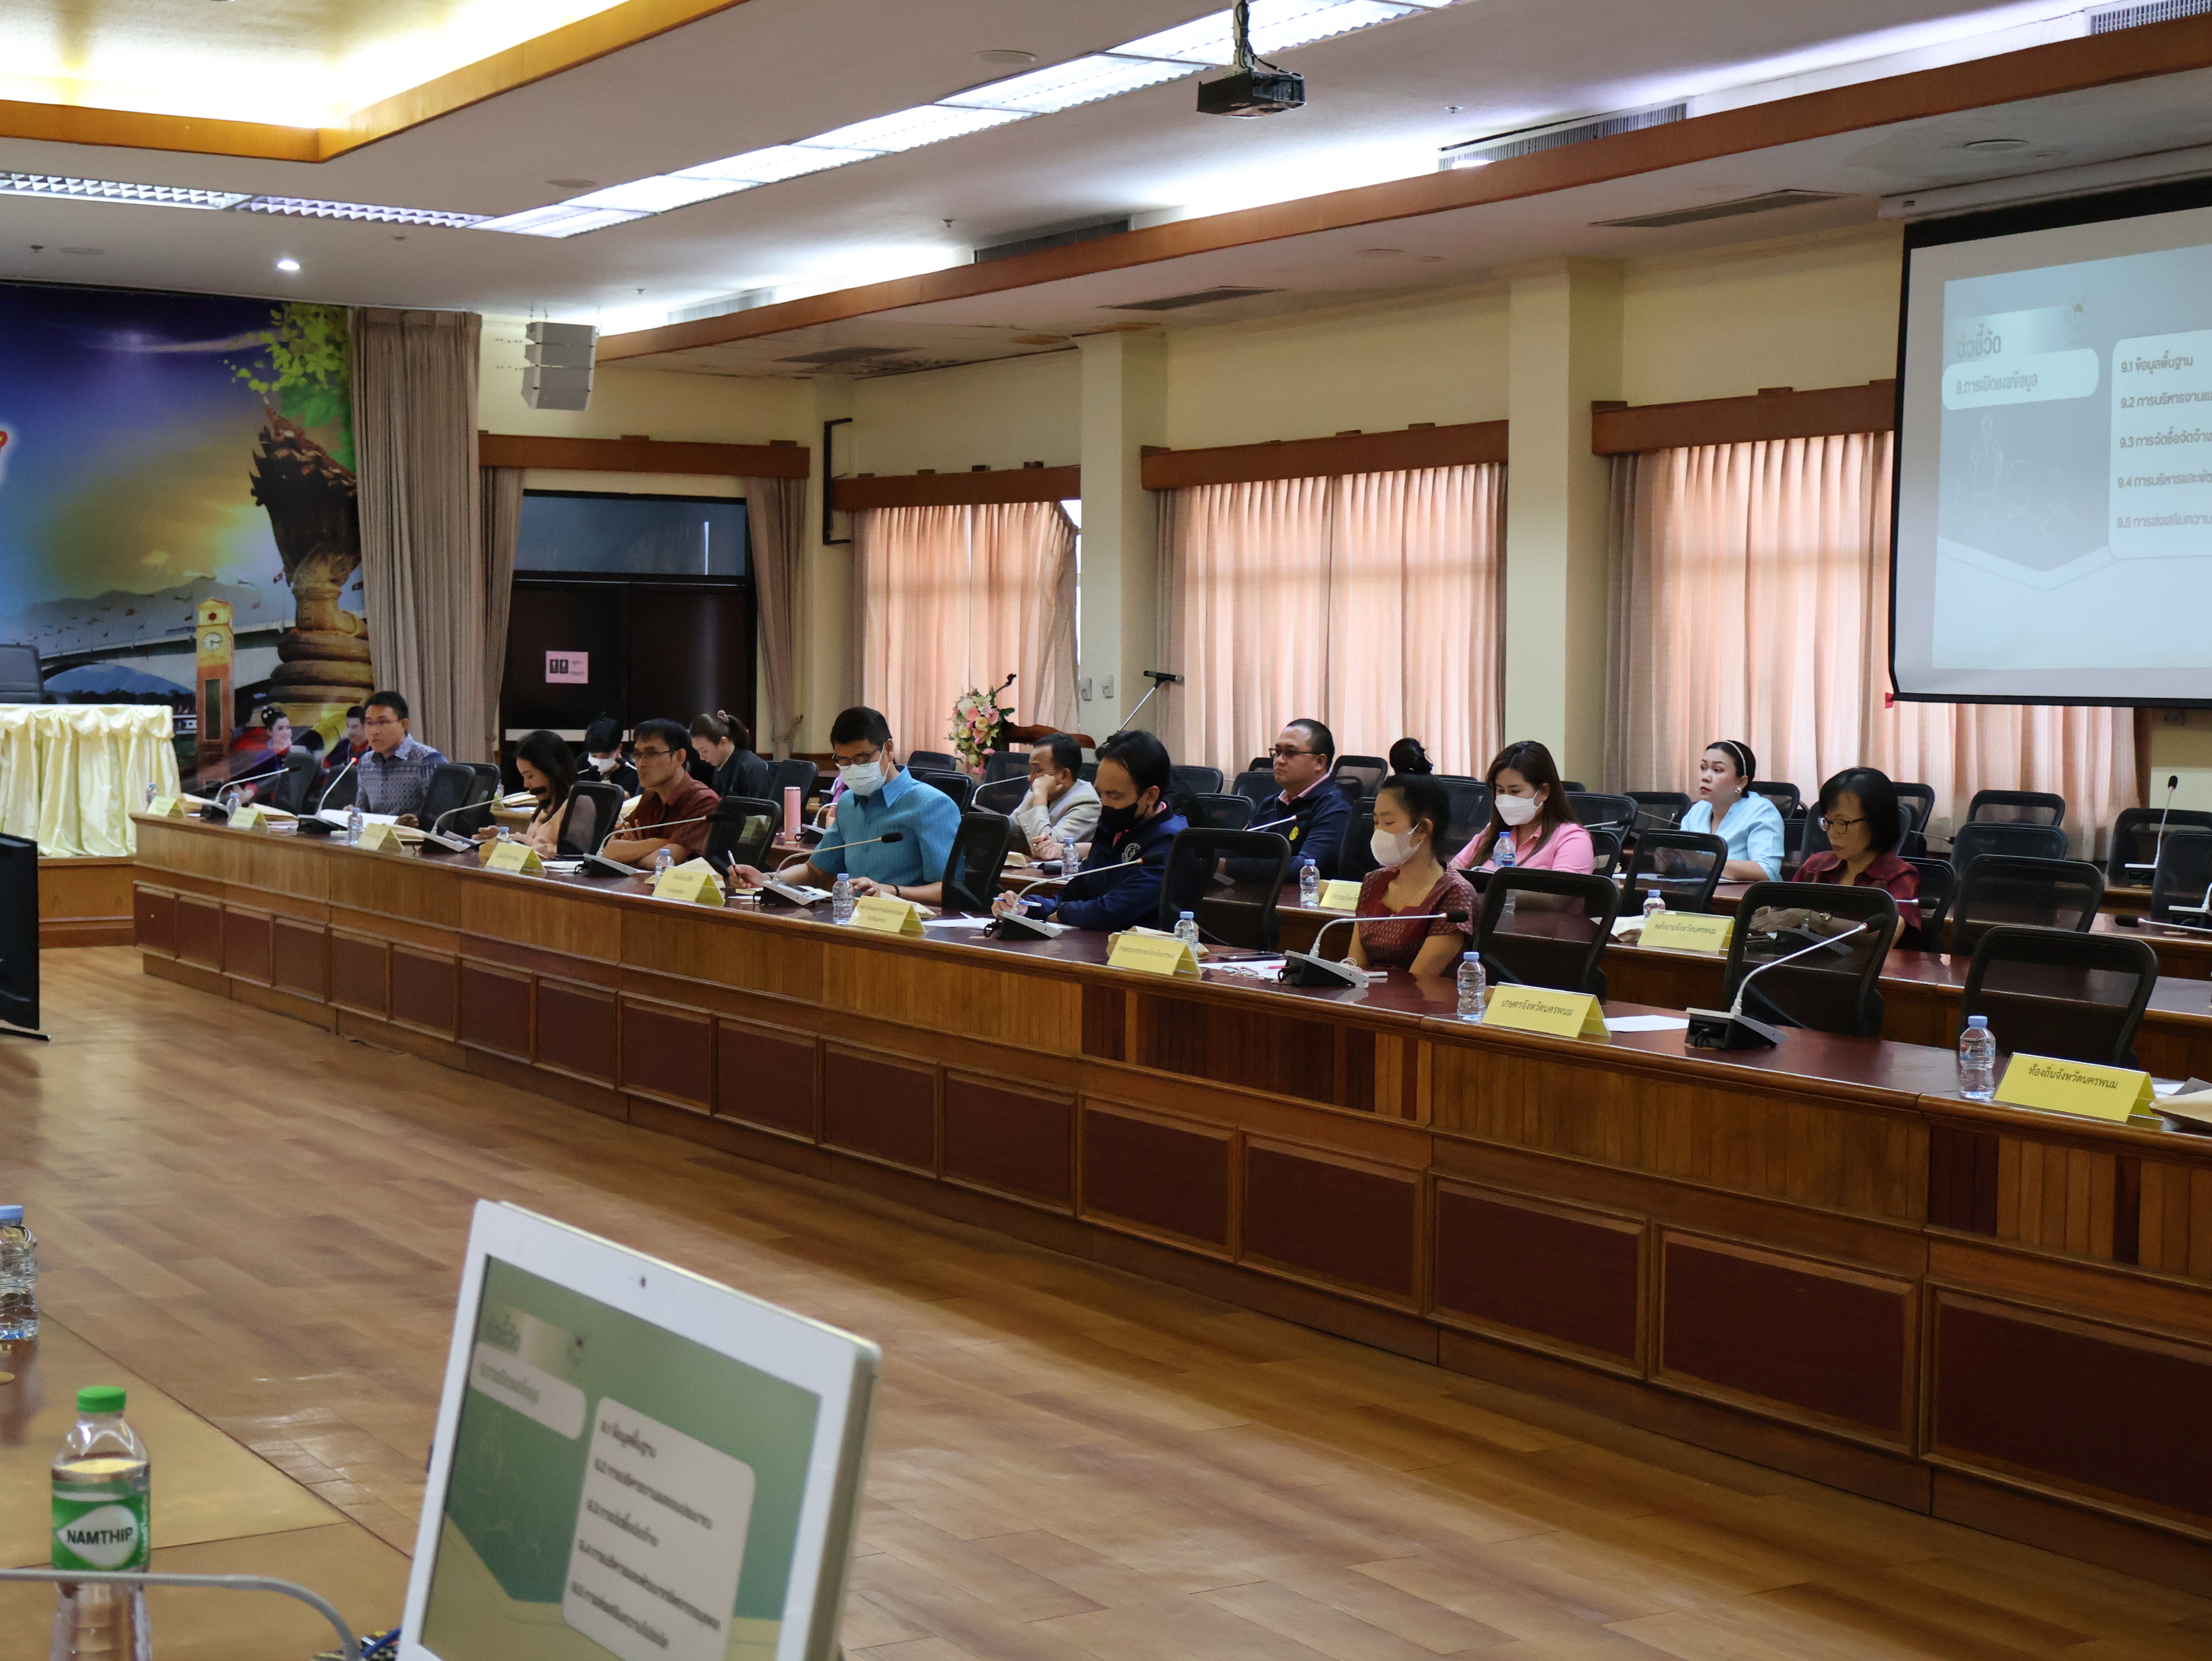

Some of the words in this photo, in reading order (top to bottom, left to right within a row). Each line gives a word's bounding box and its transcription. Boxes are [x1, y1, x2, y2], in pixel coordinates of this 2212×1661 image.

[2121, 362, 2133, 372] 9.1
[2137, 391, 2212, 407] การบริหารงานแ
[2120, 436, 2134, 448] 9.3
[2118, 477, 2131, 488] 9.4
[1501, 999, 1574, 1016] เกษตรจังหวัดนครพนม
[2028, 1063, 2119, 1089] ท้องถิ่นจังหวัดนครพนม
[67, 1526, 133, 1545] NAMTHIP
